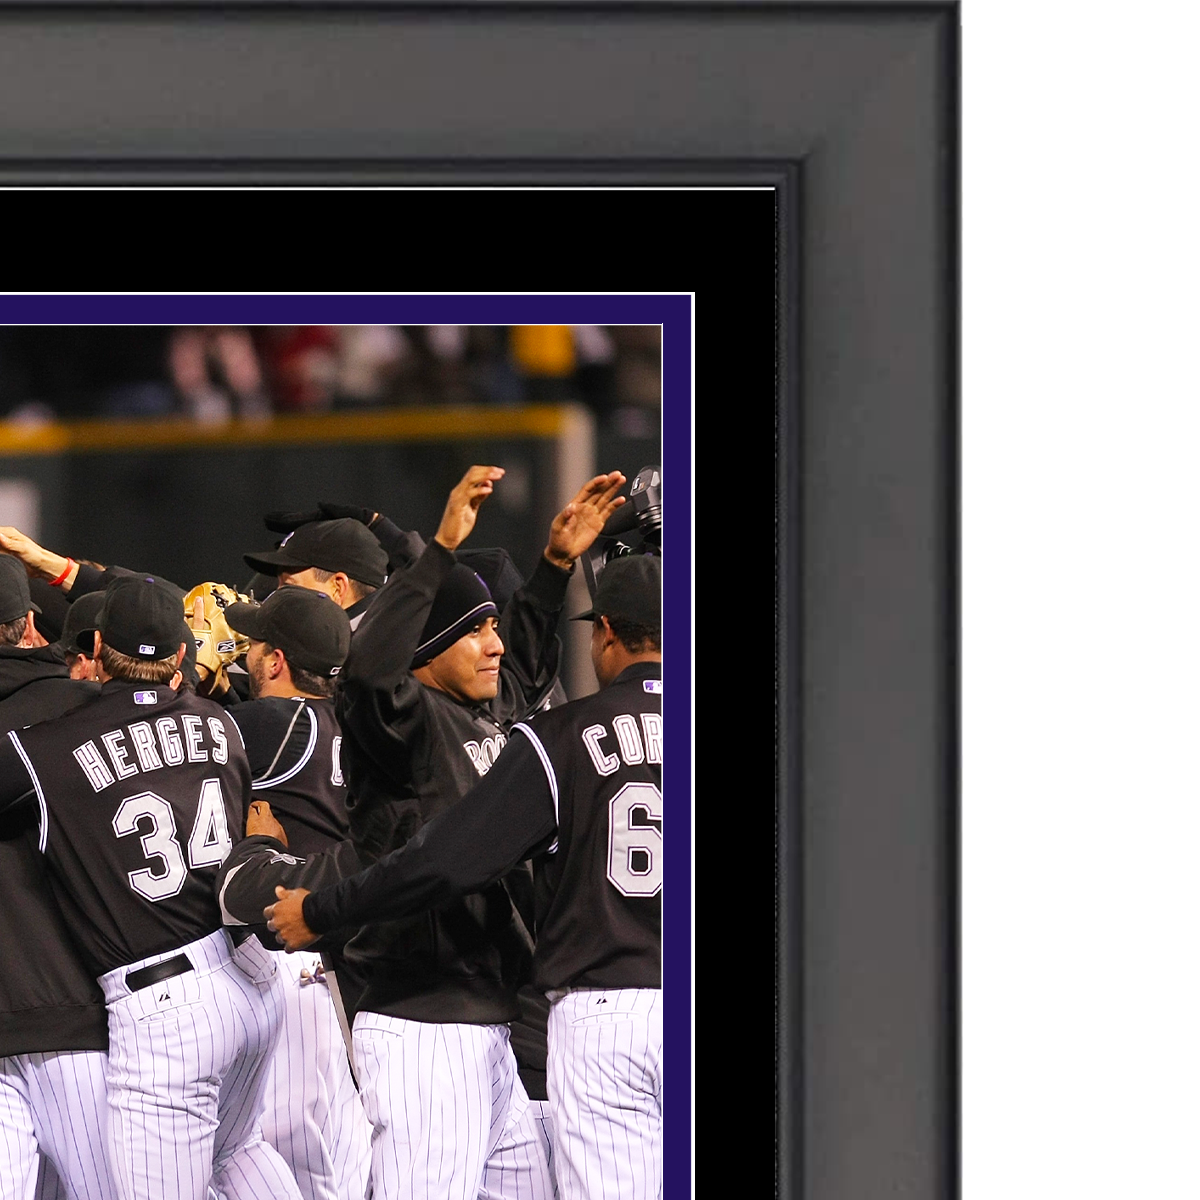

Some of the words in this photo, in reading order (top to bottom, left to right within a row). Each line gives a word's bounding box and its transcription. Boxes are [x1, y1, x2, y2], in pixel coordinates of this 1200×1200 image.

[72, 715, 229, 793] HERGES
[112, 778, 233, 903] 34
[607, 782, 662, 897] 6
